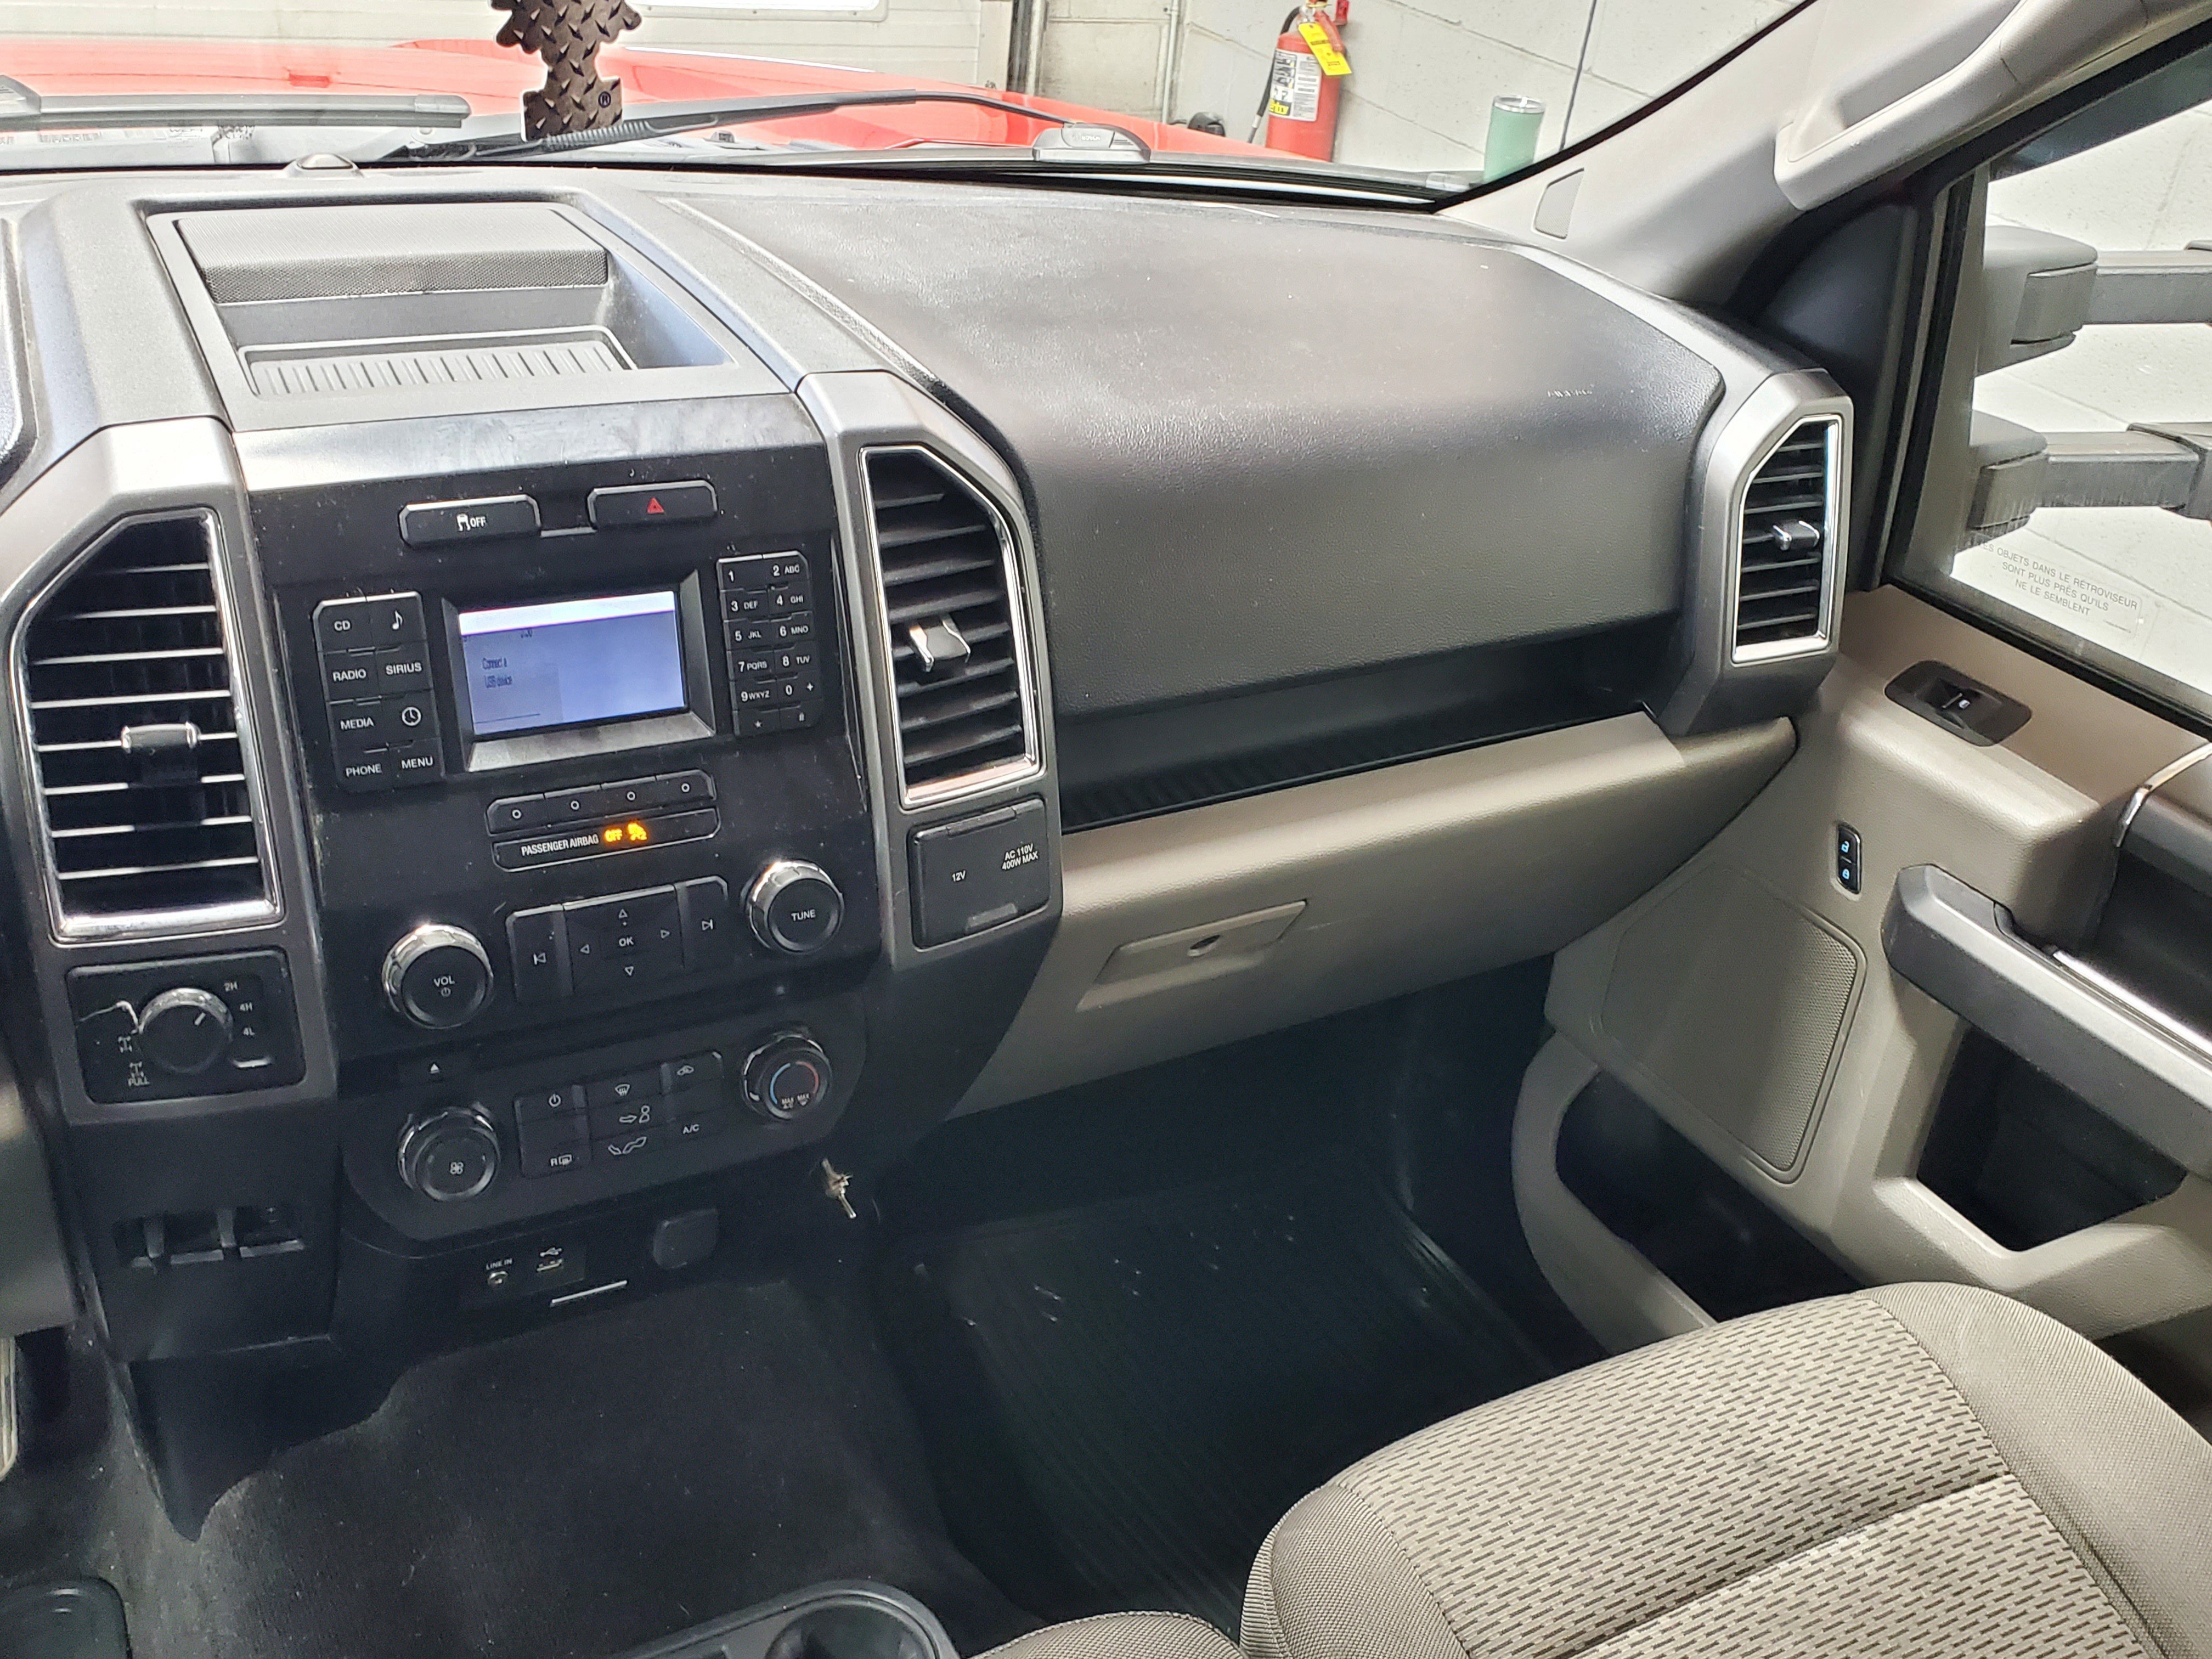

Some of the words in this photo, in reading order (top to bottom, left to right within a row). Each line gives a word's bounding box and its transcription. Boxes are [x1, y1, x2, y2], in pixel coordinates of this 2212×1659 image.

[470, 516, 486, 527] OFF
[773, 565, 780, 576] 2
[785, 565, 799, 574] ABC
[1997, 547, 2029, 567] OBJETS
[2033, 561, 2056, 577] DANS
[2059, 572, 2070, 583] LE
[728, 571, 734, 582] 1
[2002, 562, 2025, 576] SONT
[2029, 572, 2050, 587] PLUS
[2080, 593, 2109, 611] QU'ILS
[776, 595, 783, 606] 4
[2015, 579, 2028, 590] NE
[2030, 585, 2041, 596] LE
[2044, 590, 2091, 616] SEMBLENT
[731, 601, 738, 612] 3
[744, 601, 758, 610] DEF
[334, 620, 351, 631] CD
[780, 626, 787, 636] 6
[791, 625, 809, 635] MNO
[735, 631, 742, 641] 5
[748, 631, 761, 640] JKL
[738, 662, 745, 672] 7
[747, 661, 767, 670] PQRS
[783, 656, 789, 667] 8
[796, 655, 810, 664] TUV
[386, 662, 422, 675] SIRIUS
[332, 669, 366, 682] RADIO
[741, 691, 748, 702] 9
[749, 690, 770, 700] WXYZ
[786, 685, 792, 696] 0
[340, 718, 374, 730] MEDIA
[402, 757, 433, 769] MENU
[346, 763, 382, 777] PHONE
[521, 839, 569, 856] PASSENGER
[569, 834, 599, 848] AIRBAG
[605, 828, 622, 842] OFF
[1005, 850, 1015, 861] AC
[1017, 843, 1034, 857] 110V
[1002, 857, 1022, 870] 400W
[1022, 851, 1039, 864] MAX
[952, 870, 966, 882] 12V
[792, 909, 816, 922] TUNE
[619, 936, 634, 946] OK
[224, 981, 238, 992] 2H
[433, 975, 455, 988] VOL
[240, 1002, 252, 1011] 4H
[243, 1027, 255, 1036] 4L
[128, 1076, 150, 1087] PULL
[683, 1124, 698, 1134] A/C
[550, 1158, 557, 1166] R
[486, 1261, 503, 1270] LINE
